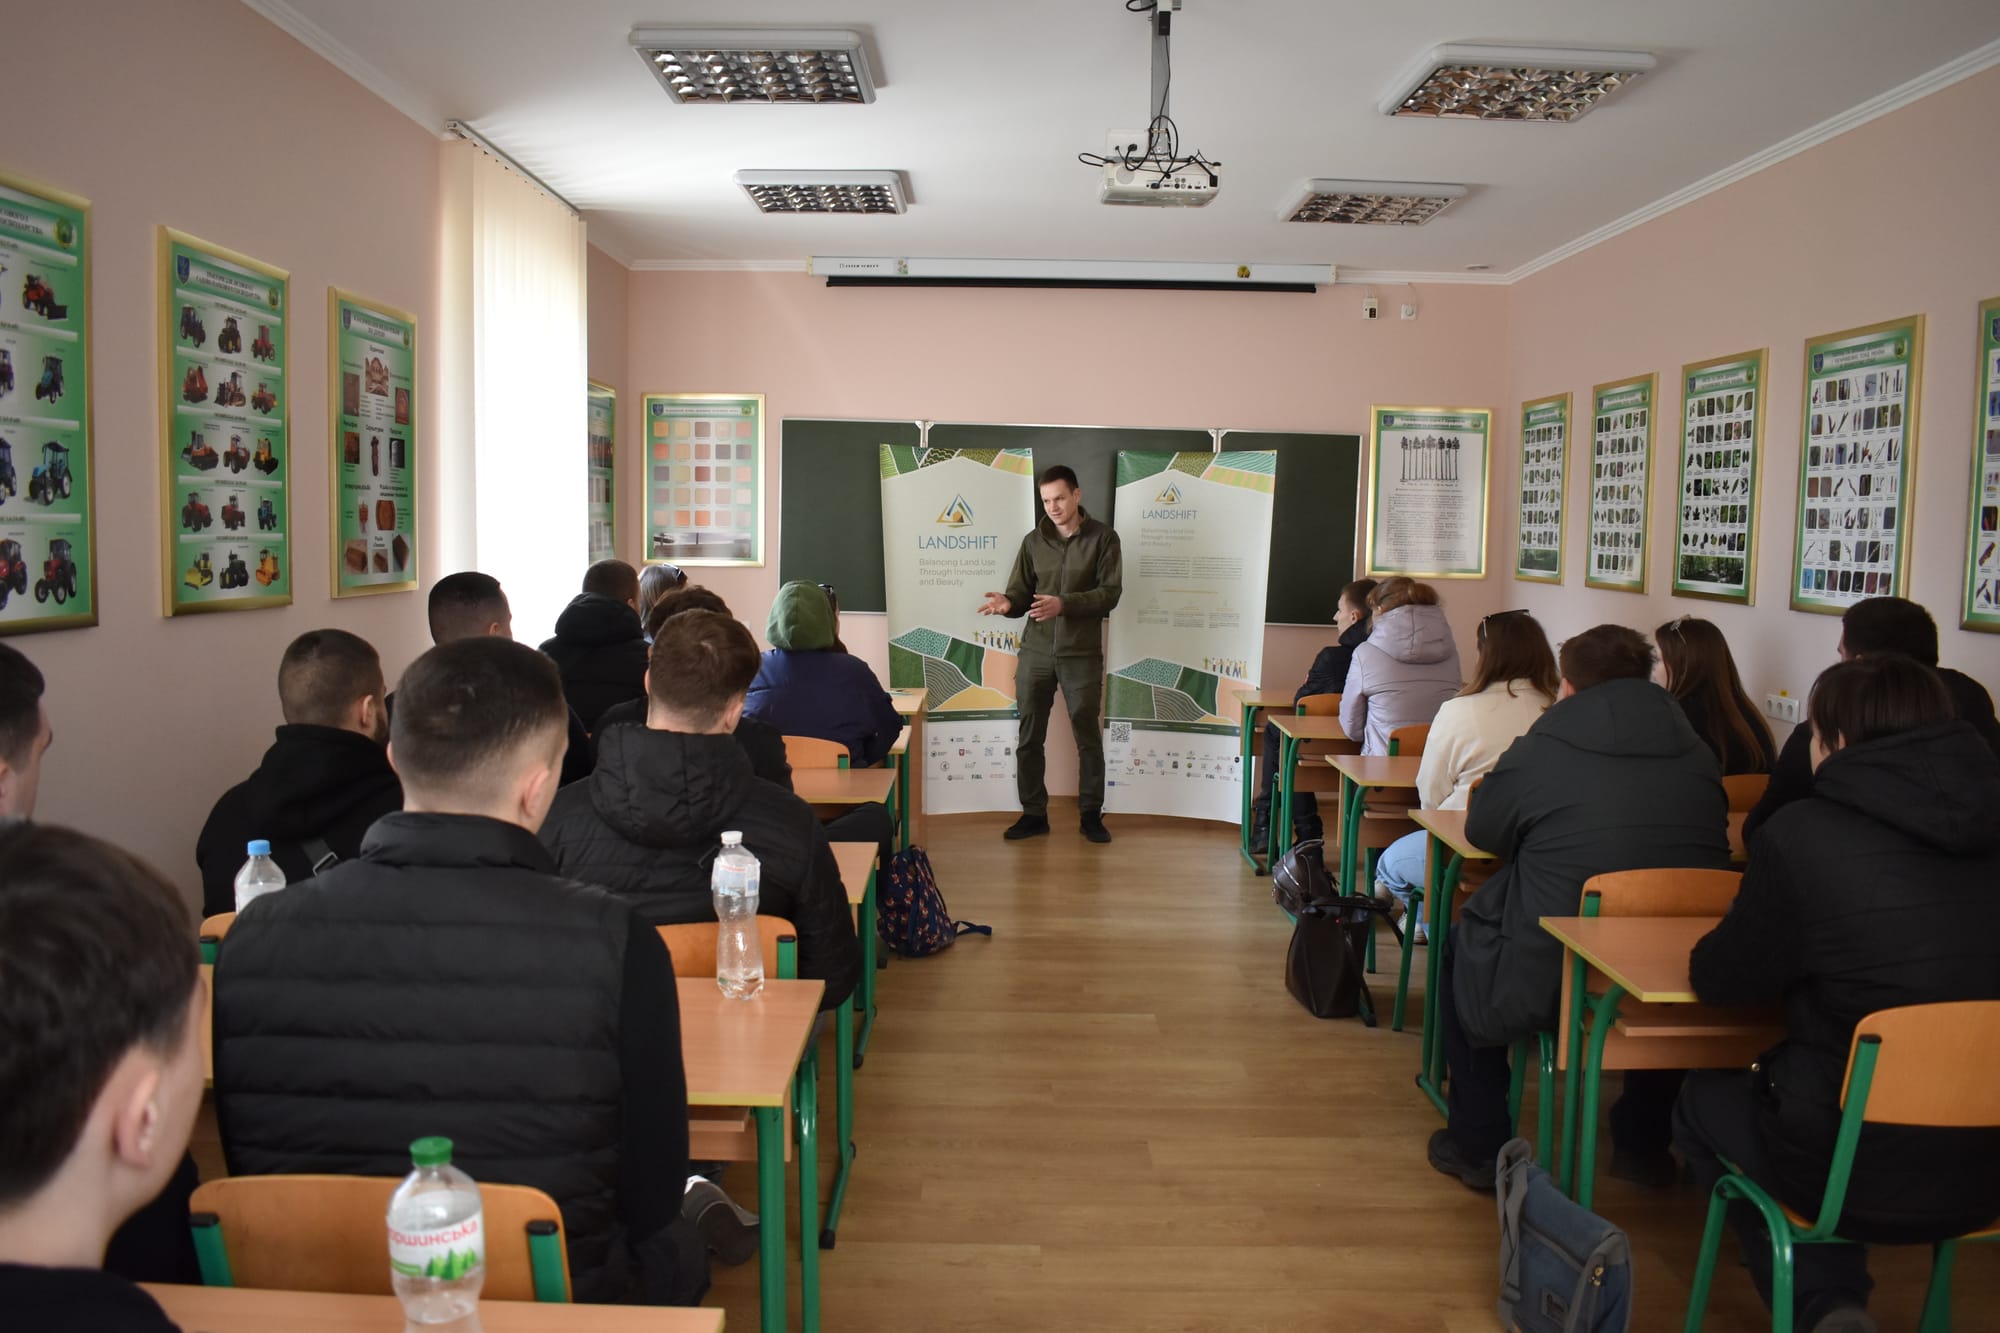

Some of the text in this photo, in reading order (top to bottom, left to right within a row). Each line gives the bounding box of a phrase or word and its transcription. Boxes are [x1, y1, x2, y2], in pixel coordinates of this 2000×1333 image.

[1142, 509, 1198, 520] LANDSHIFT
[918, 535, 998, 549] LANDSHIFT
[919, 558, 959, 567] Balancing
[920, 568, 996, 577] Through Innovation
[936, 578, 963, 588] Beauty
